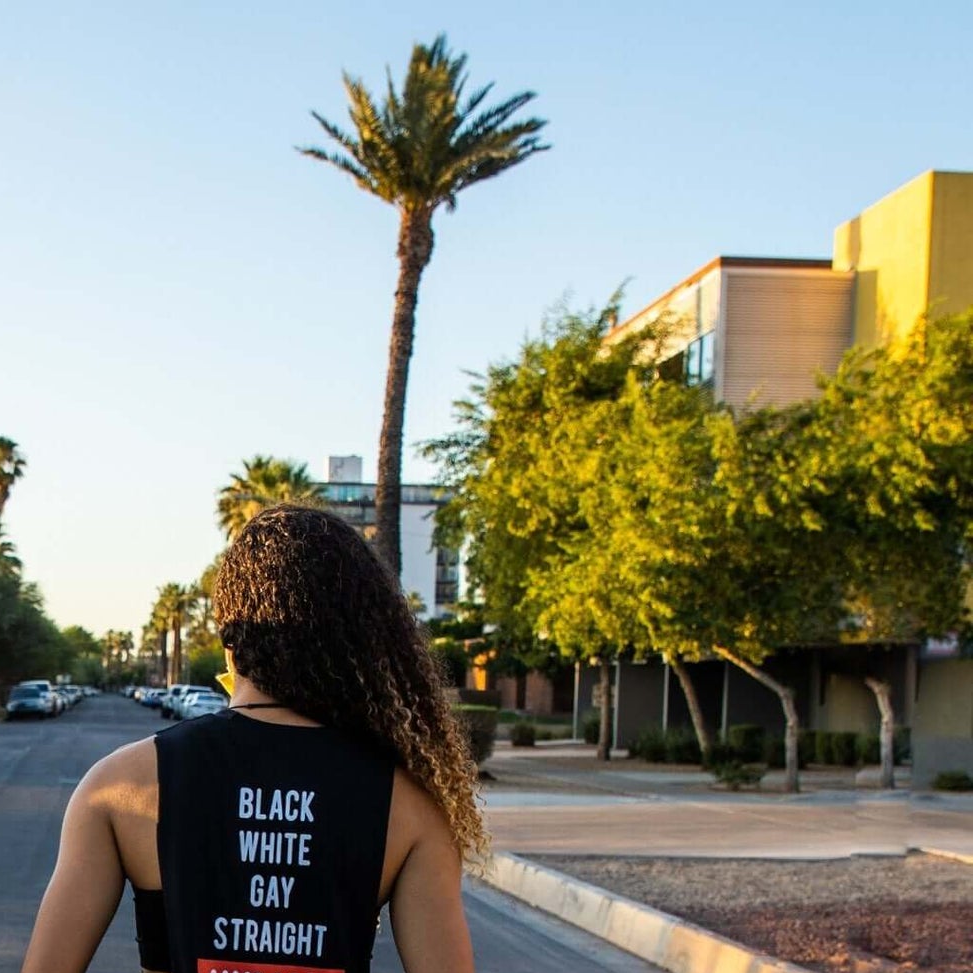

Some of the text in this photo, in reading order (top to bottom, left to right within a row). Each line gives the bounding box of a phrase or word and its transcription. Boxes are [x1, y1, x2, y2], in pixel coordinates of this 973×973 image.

[238, 787, 315, 822] BLACK
[239, 830, 312, 866] WHITE
[250, 874, 295, 909] GAY
[213, 916, 327, 957] STRAIGHT
